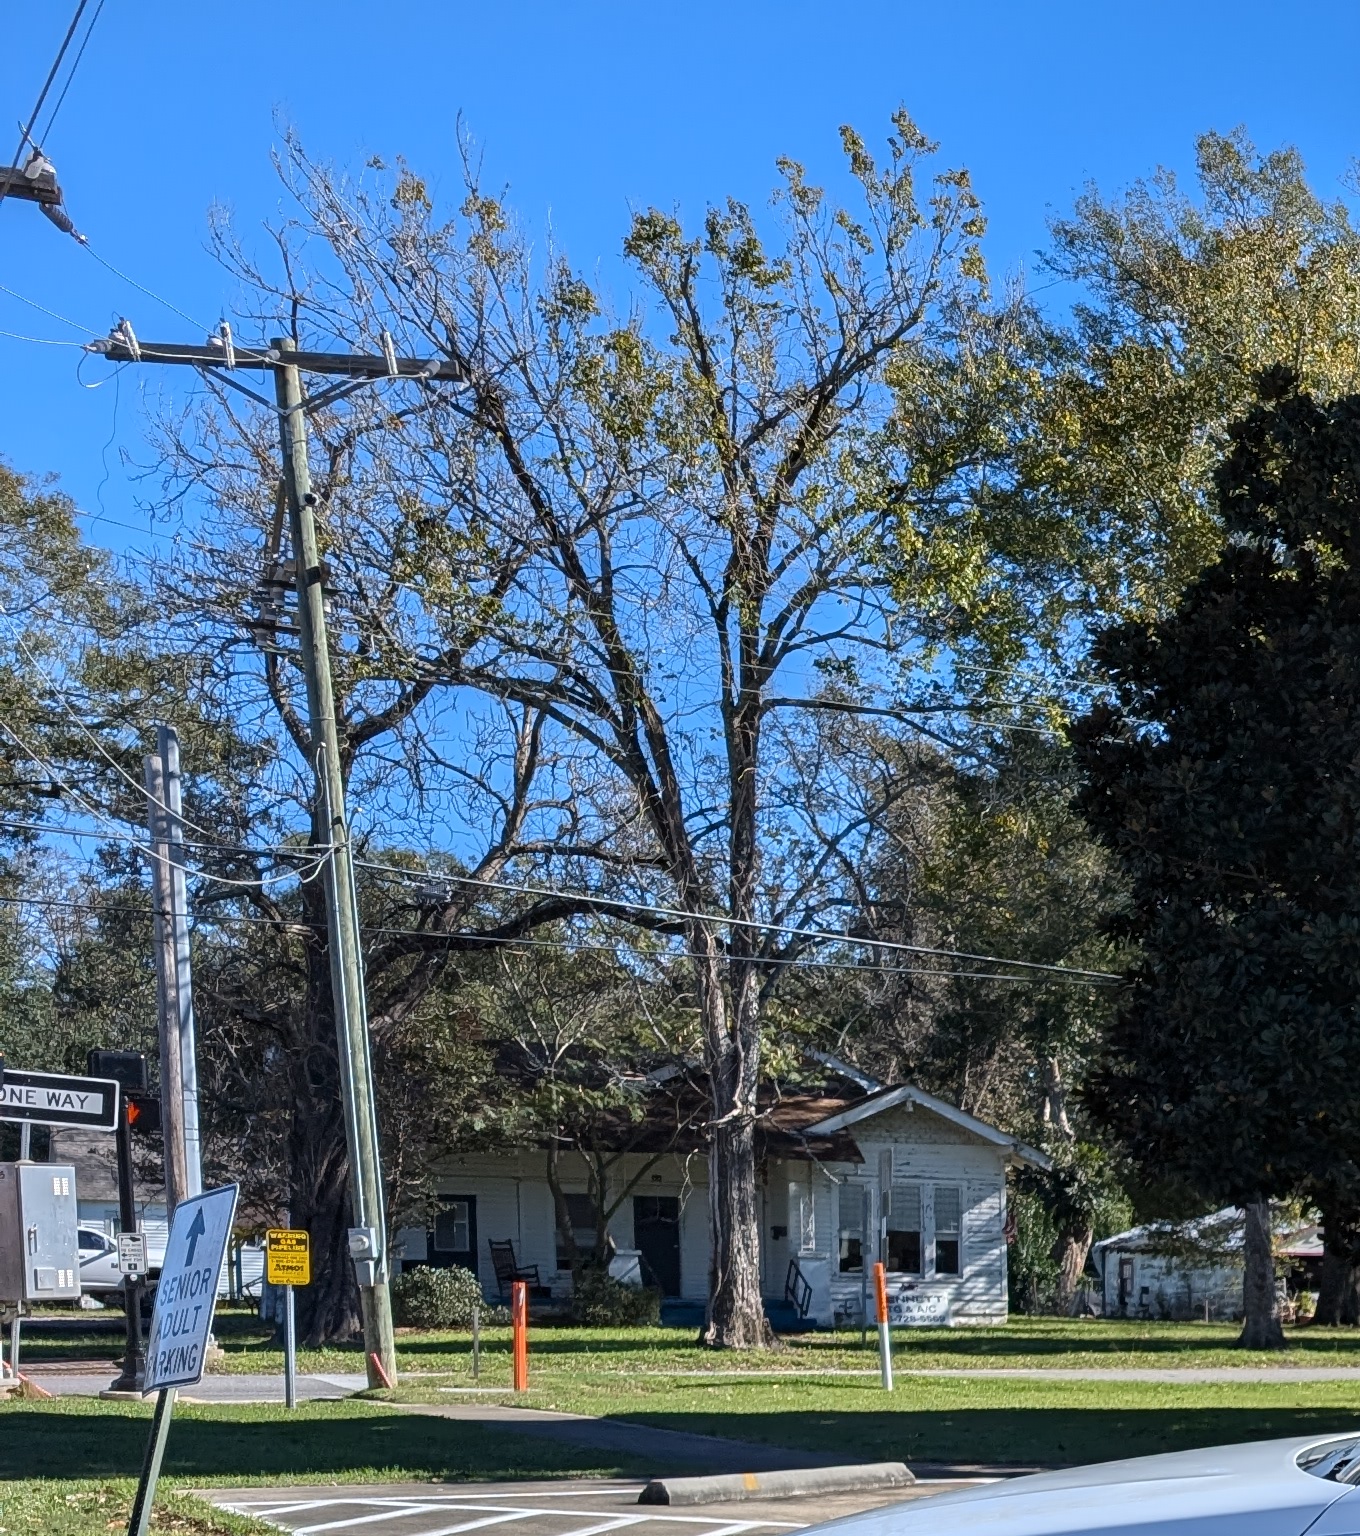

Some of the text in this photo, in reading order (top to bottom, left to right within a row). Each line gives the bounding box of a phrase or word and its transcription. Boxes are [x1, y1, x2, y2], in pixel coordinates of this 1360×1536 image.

[46, 1091, 89, 1110] WAY
[160, 1267, 212, 1307] SENIOR
[887, 1295, 943, 1304] ENNETT
[917, 1305, 936, 1314] A/C
[155, 1305, 202, 1343] ADULT
[146, 1343, 199, 1382] PARKING
